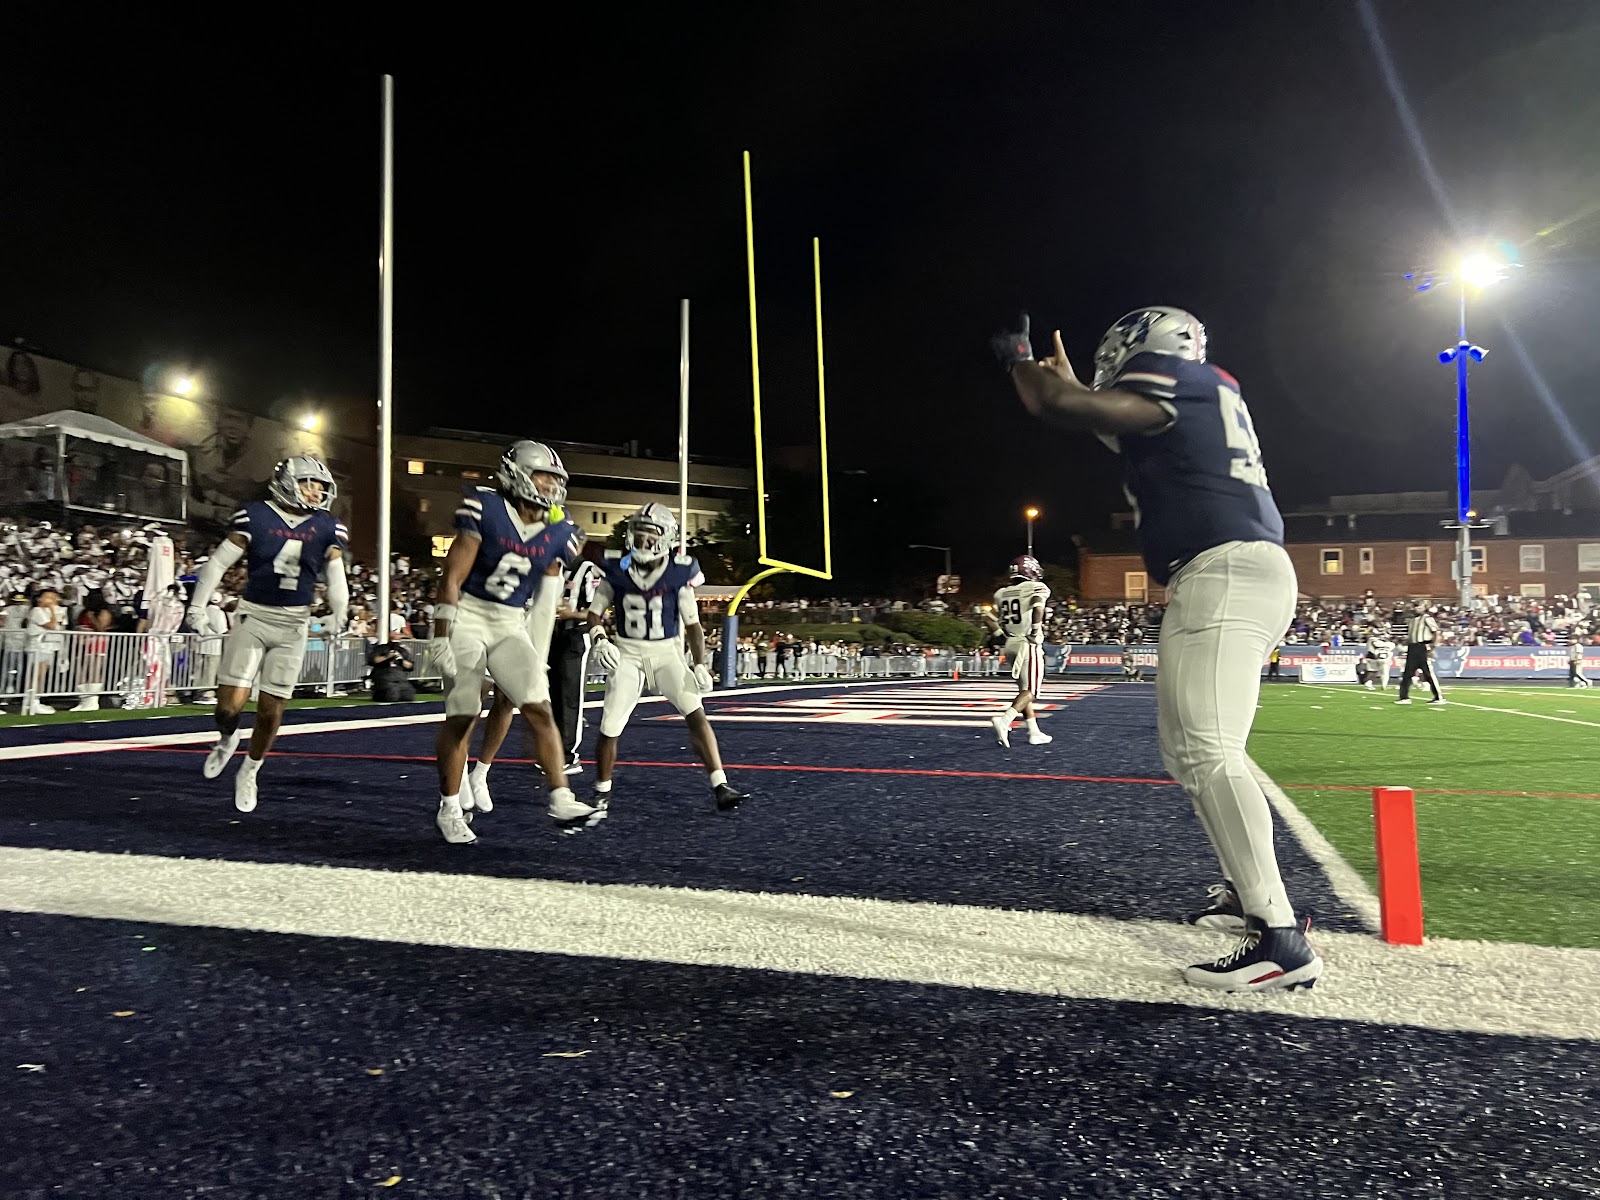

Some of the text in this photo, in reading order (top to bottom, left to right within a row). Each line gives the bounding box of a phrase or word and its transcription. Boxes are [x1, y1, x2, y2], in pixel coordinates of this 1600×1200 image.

[273, 538, 304, 592] 4
[483, 551, 533, 601] 6
[622, 593, 666, 640] 81
[1001, 598, 1022, 625] 29
[1070, 656, 1123, 664] BLEED BLUE
[1469, 657, 1531, 668] BLEED BLUE
